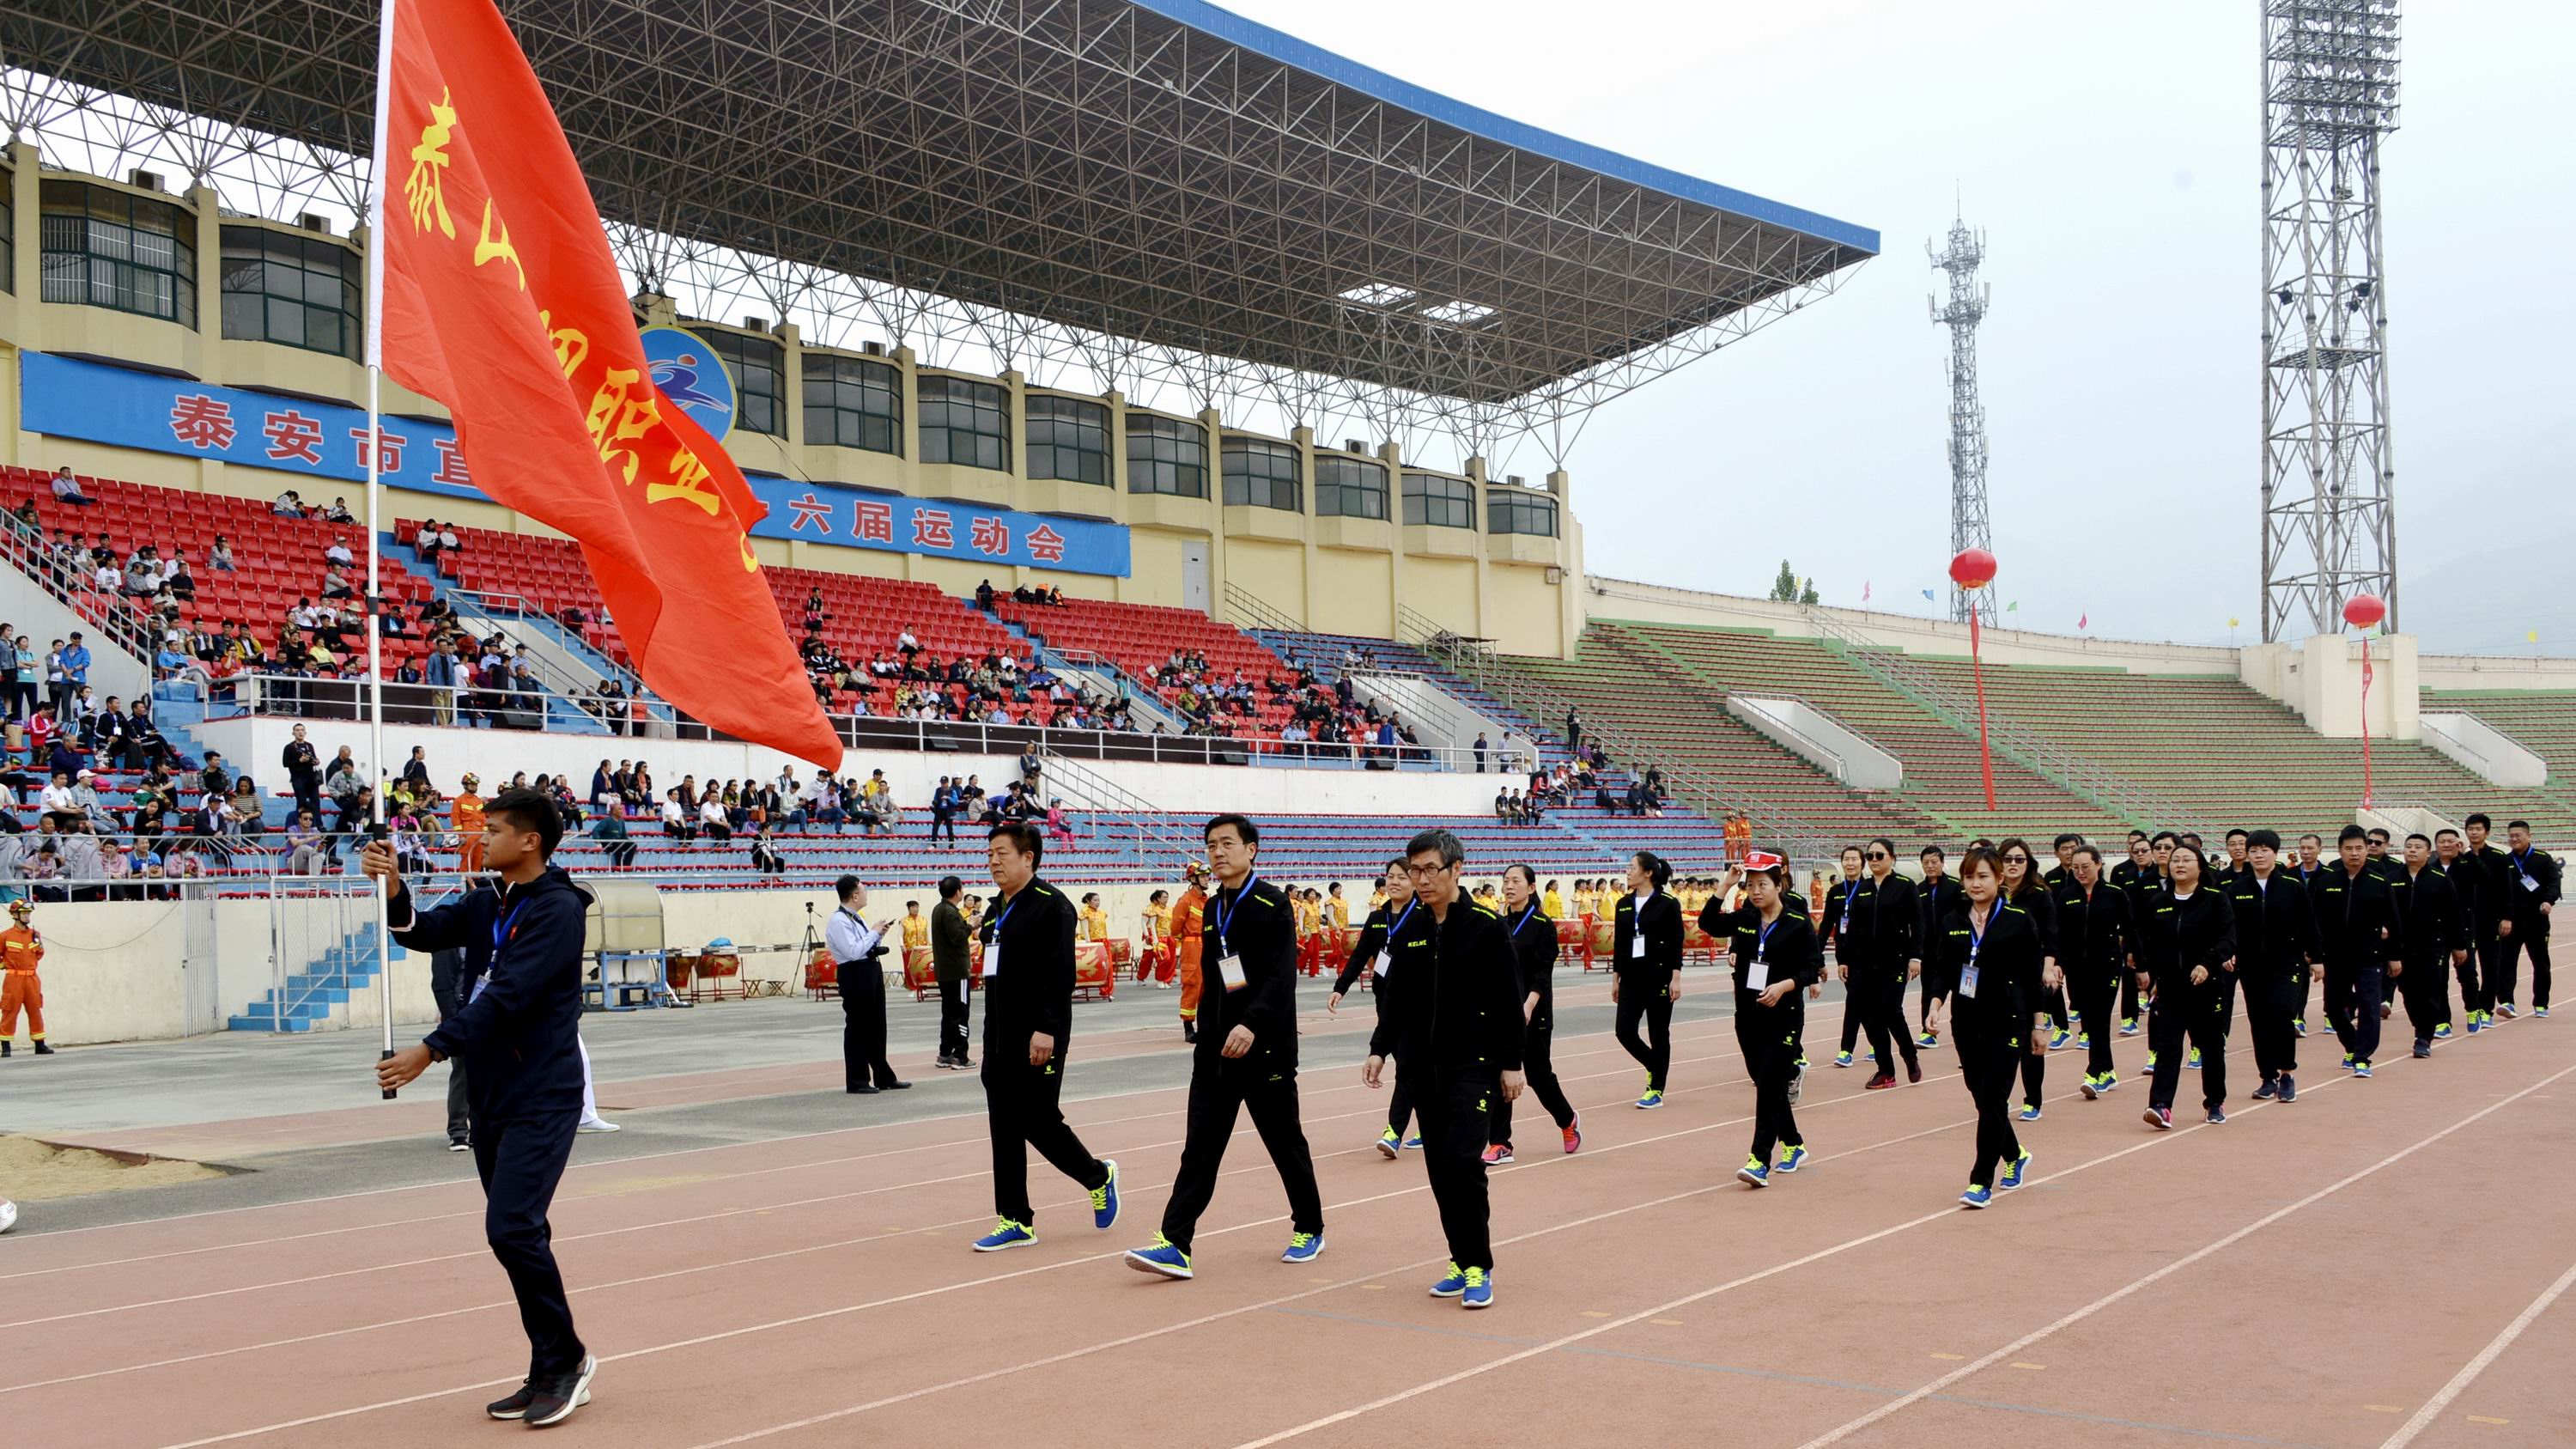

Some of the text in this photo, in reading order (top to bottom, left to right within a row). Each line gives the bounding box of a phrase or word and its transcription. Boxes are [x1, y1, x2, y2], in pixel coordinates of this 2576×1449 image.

[760, 492, 1066, 563] 六届运动会
[1407, 939, 1427, 947] KELME
